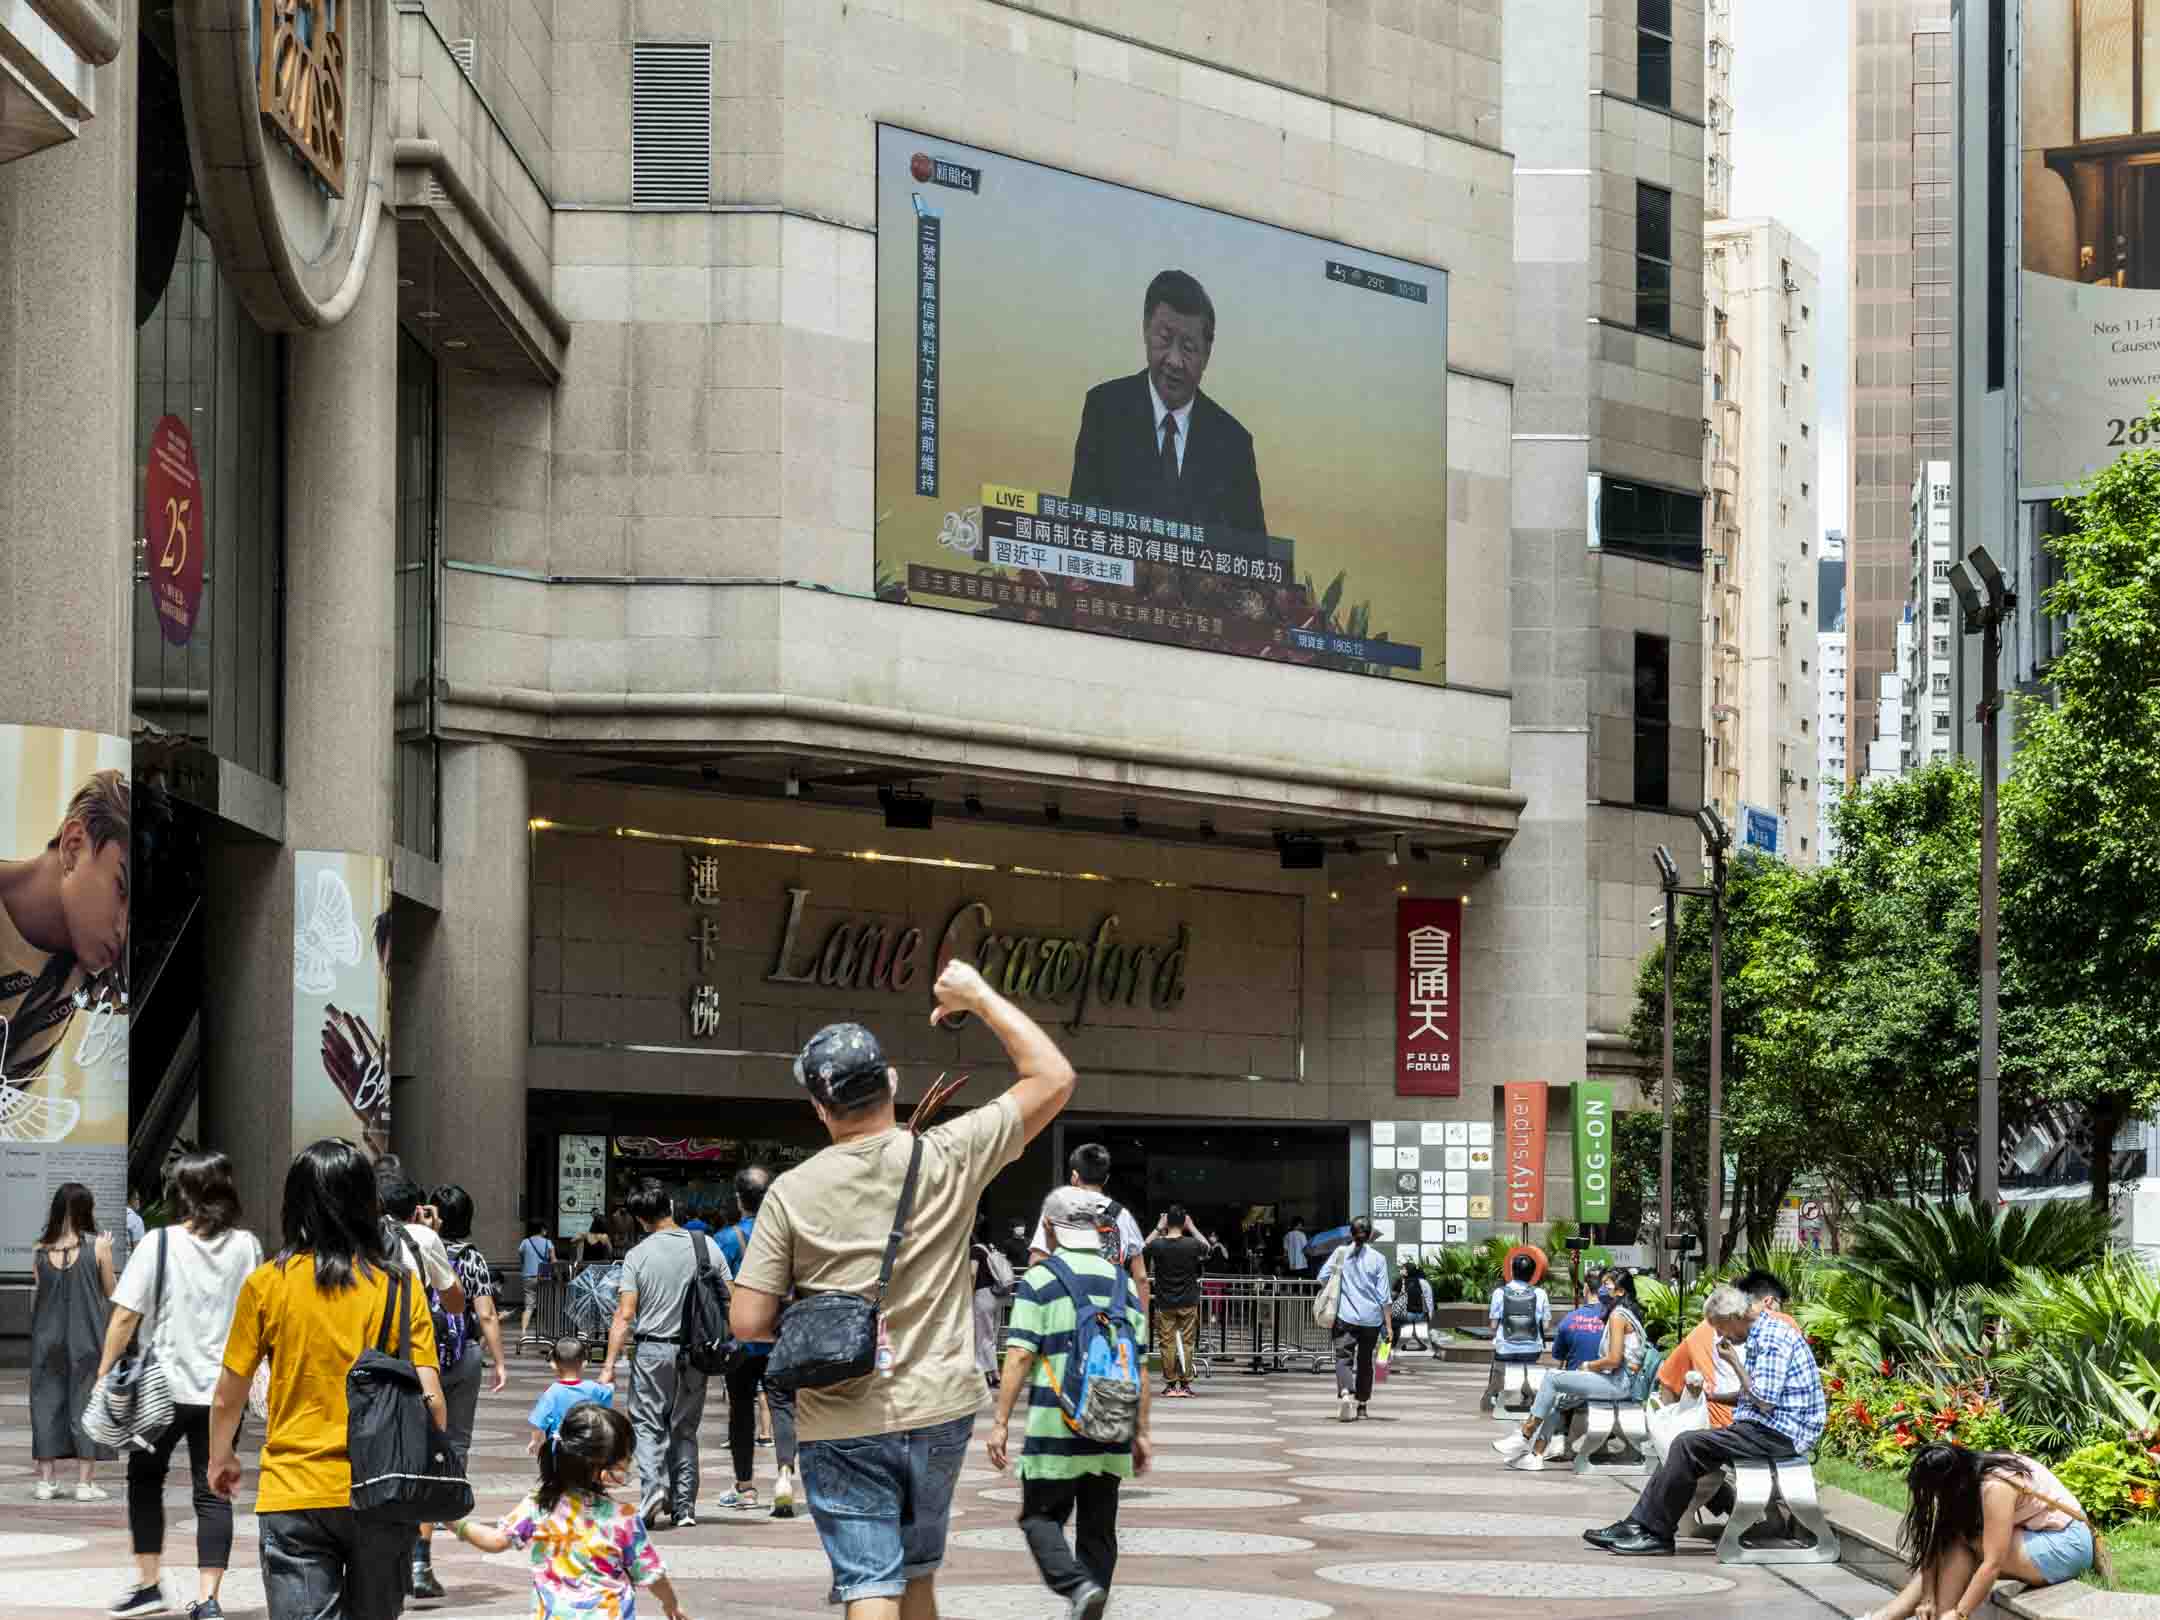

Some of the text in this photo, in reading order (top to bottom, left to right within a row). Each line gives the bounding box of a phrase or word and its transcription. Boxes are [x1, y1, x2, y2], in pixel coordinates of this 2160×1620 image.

[935, 162, 973, 188] 新聞台
[2094, 320, 2120, 334] Nos
[996, 491, 1025, 508] LIVE
[159, 496, 191, 576] 25
[996, 515, 1282, 583] 一國兩制在香港取得舉世公認的成功
[994, 542, 1123, 580] 習近平 國家主席
[768, 887, 921, 992] Lane
[1407, 925, 1451, 1041] 食通天
[1406, 1062, 1451, 1072] FORUM
[1407, 1053, 1450, 1062] FOOD
[1585, 1100, 1606, 1206] LOG-ON
[1374, 1196, 1419, 1213] 食通天
